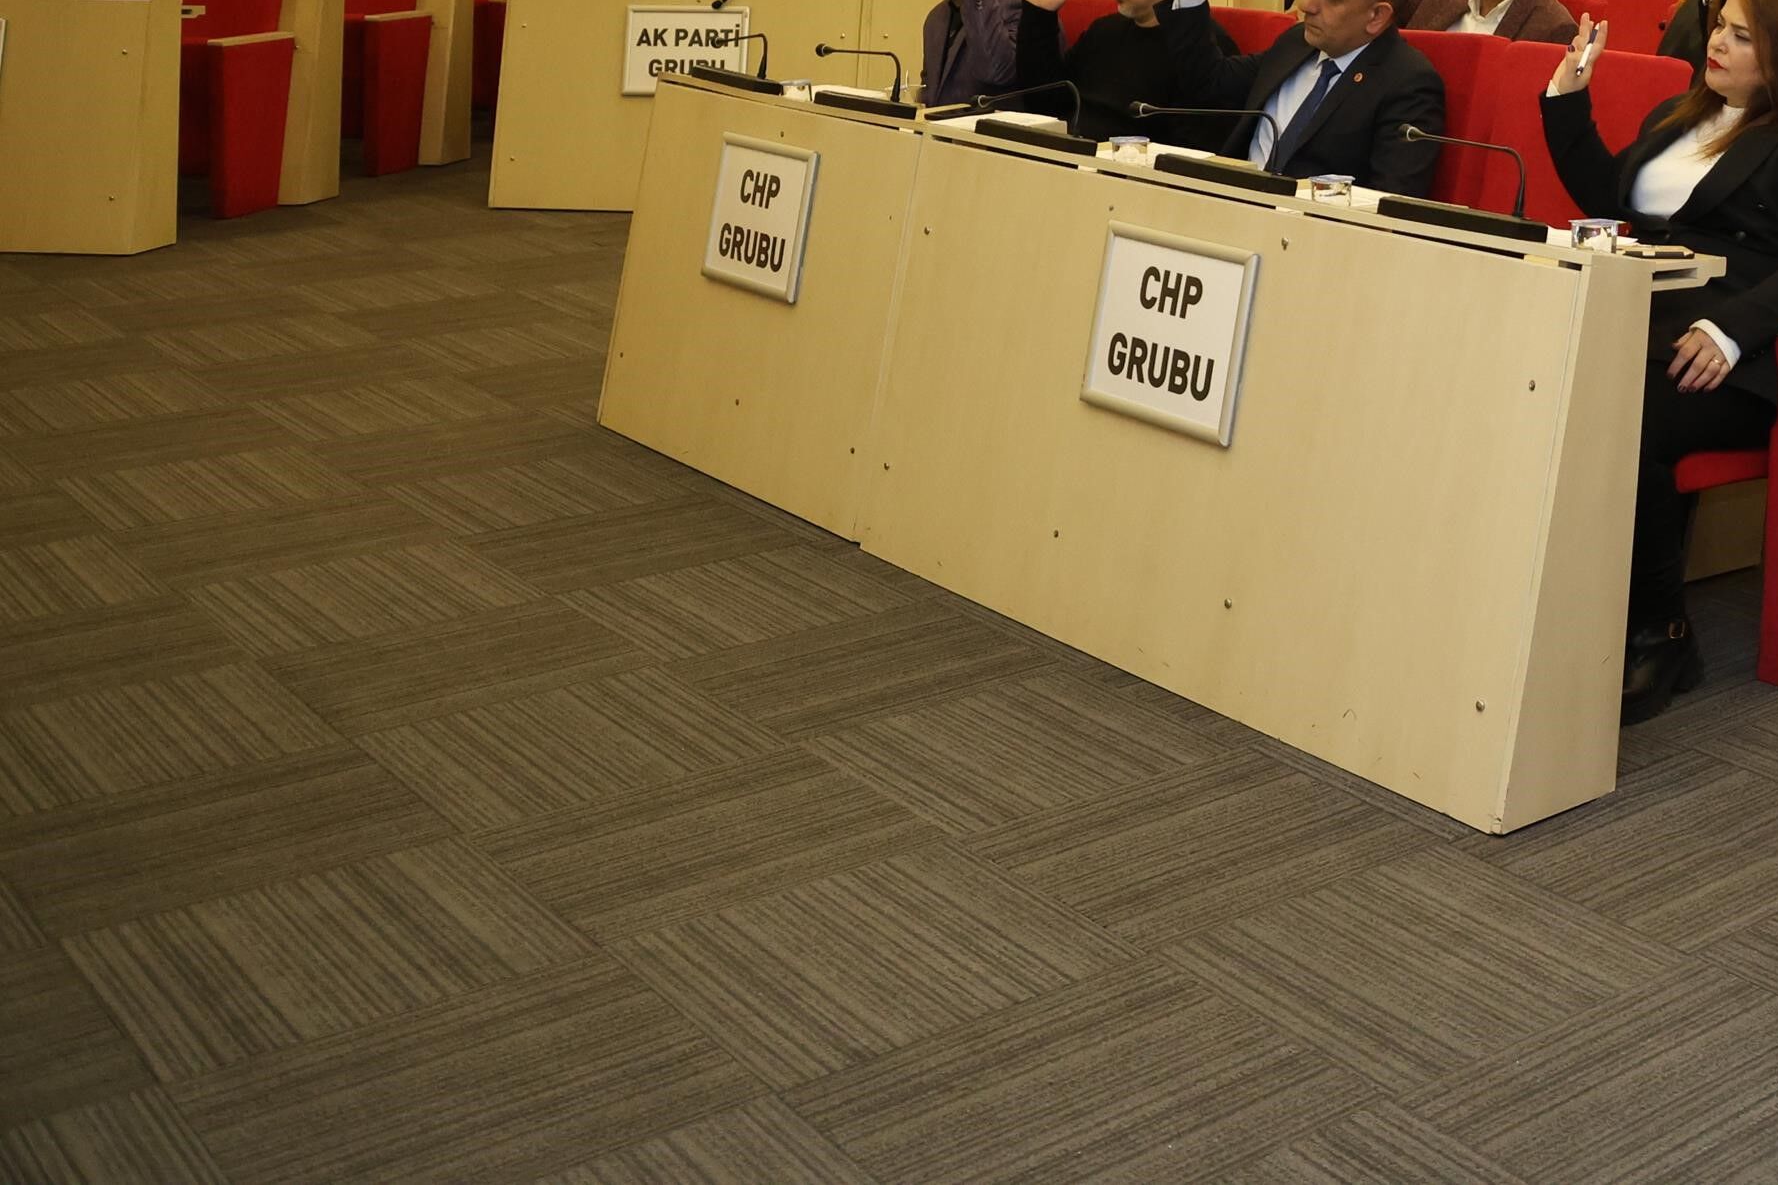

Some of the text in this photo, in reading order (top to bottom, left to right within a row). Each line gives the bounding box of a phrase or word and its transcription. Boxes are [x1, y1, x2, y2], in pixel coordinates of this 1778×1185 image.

[636, 23, 740, 48] AK PARTİ
[740, 169, 781, 209] CHP
[718, 222, 786, 273] GRUBU
[1139, 266, 1204, 319] CHP
[1107, 332, 1215, 402] GRUBU
